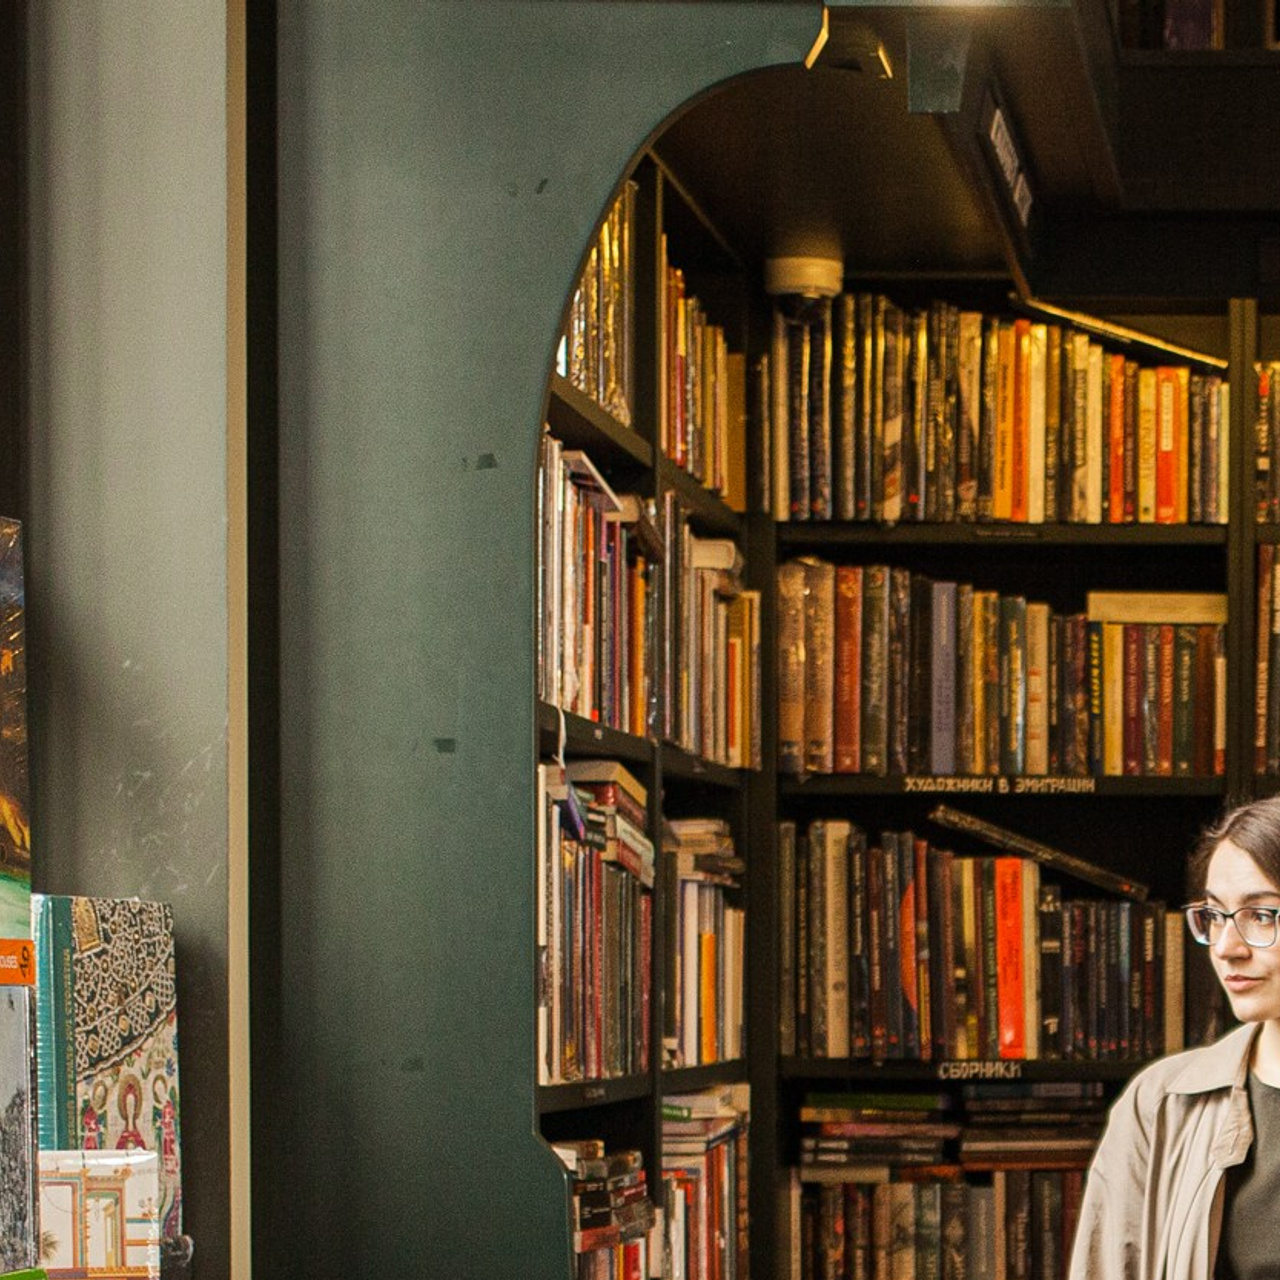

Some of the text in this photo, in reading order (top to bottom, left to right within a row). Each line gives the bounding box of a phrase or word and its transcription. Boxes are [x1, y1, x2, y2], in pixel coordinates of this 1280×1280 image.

[904, 777, 994, 793] ХУДОЖНИКИ
[999, 777, 1010, 794] В
[938, 1061, 1022, 1080] СБОРНИКИ
